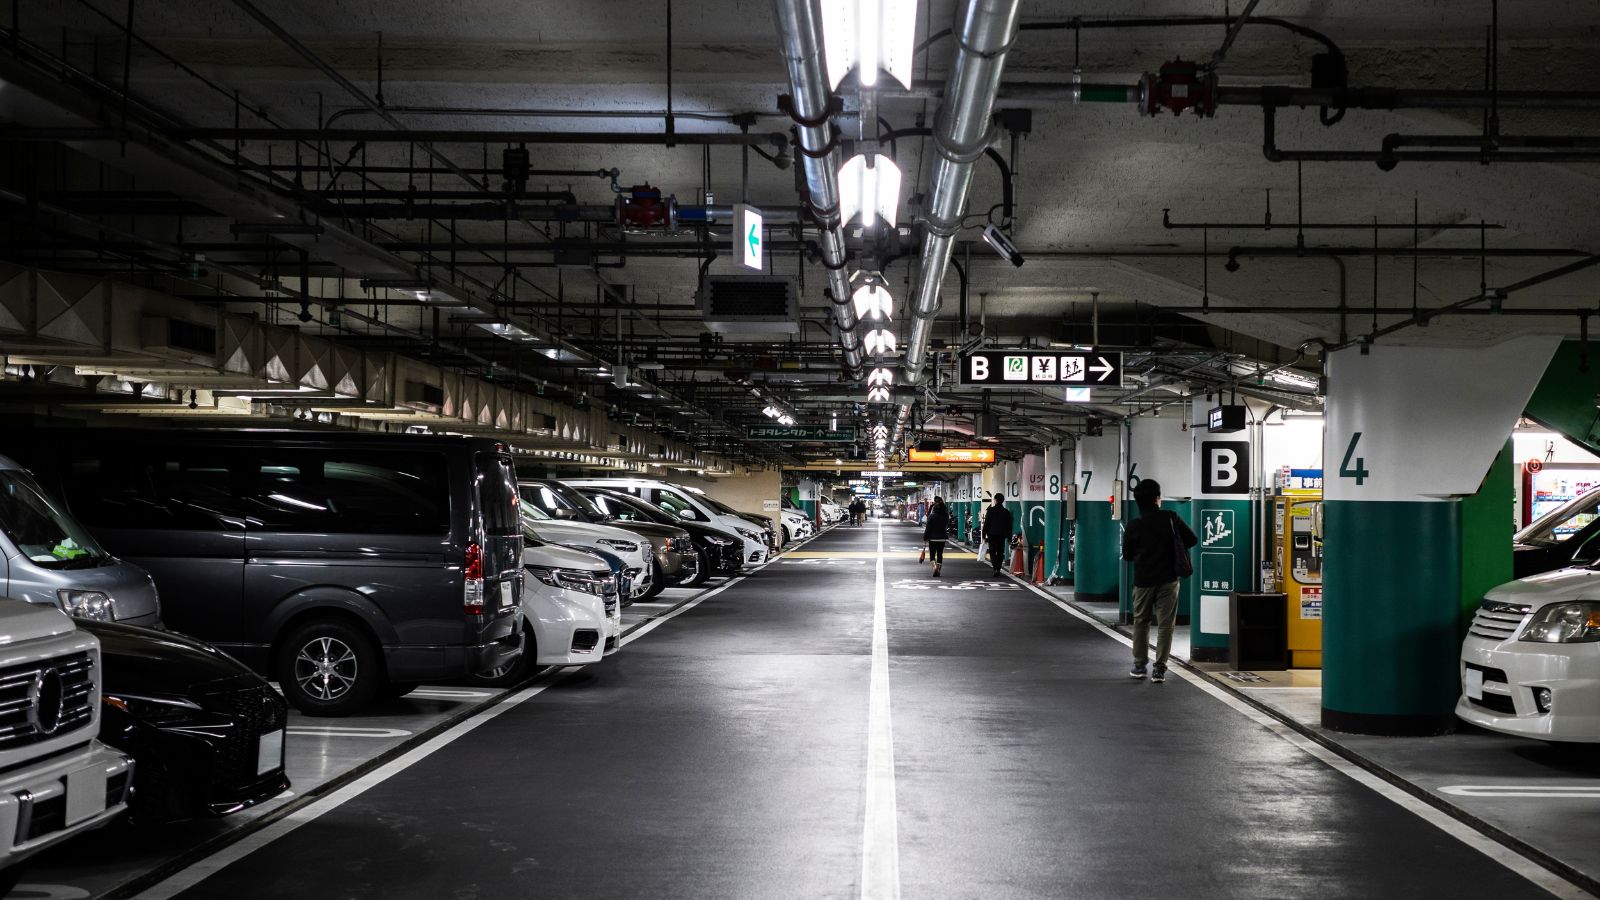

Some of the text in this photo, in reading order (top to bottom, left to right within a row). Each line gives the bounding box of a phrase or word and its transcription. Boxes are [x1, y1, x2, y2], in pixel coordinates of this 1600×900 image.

[971, 356, 990, 381] B
[750, 428, 814, 437] トヨタレンタカー
[1210, 448, 1238, 487] B
[1339, 431, 1369, 486] 4
[1049, 475, 1059, 495] 8
[1081, 471, 1093, 495] 7
[1128, 463, 1142, 492] 6
[973, 486, 982, 499] 13
[1006, 482, 1019, 498] 10
